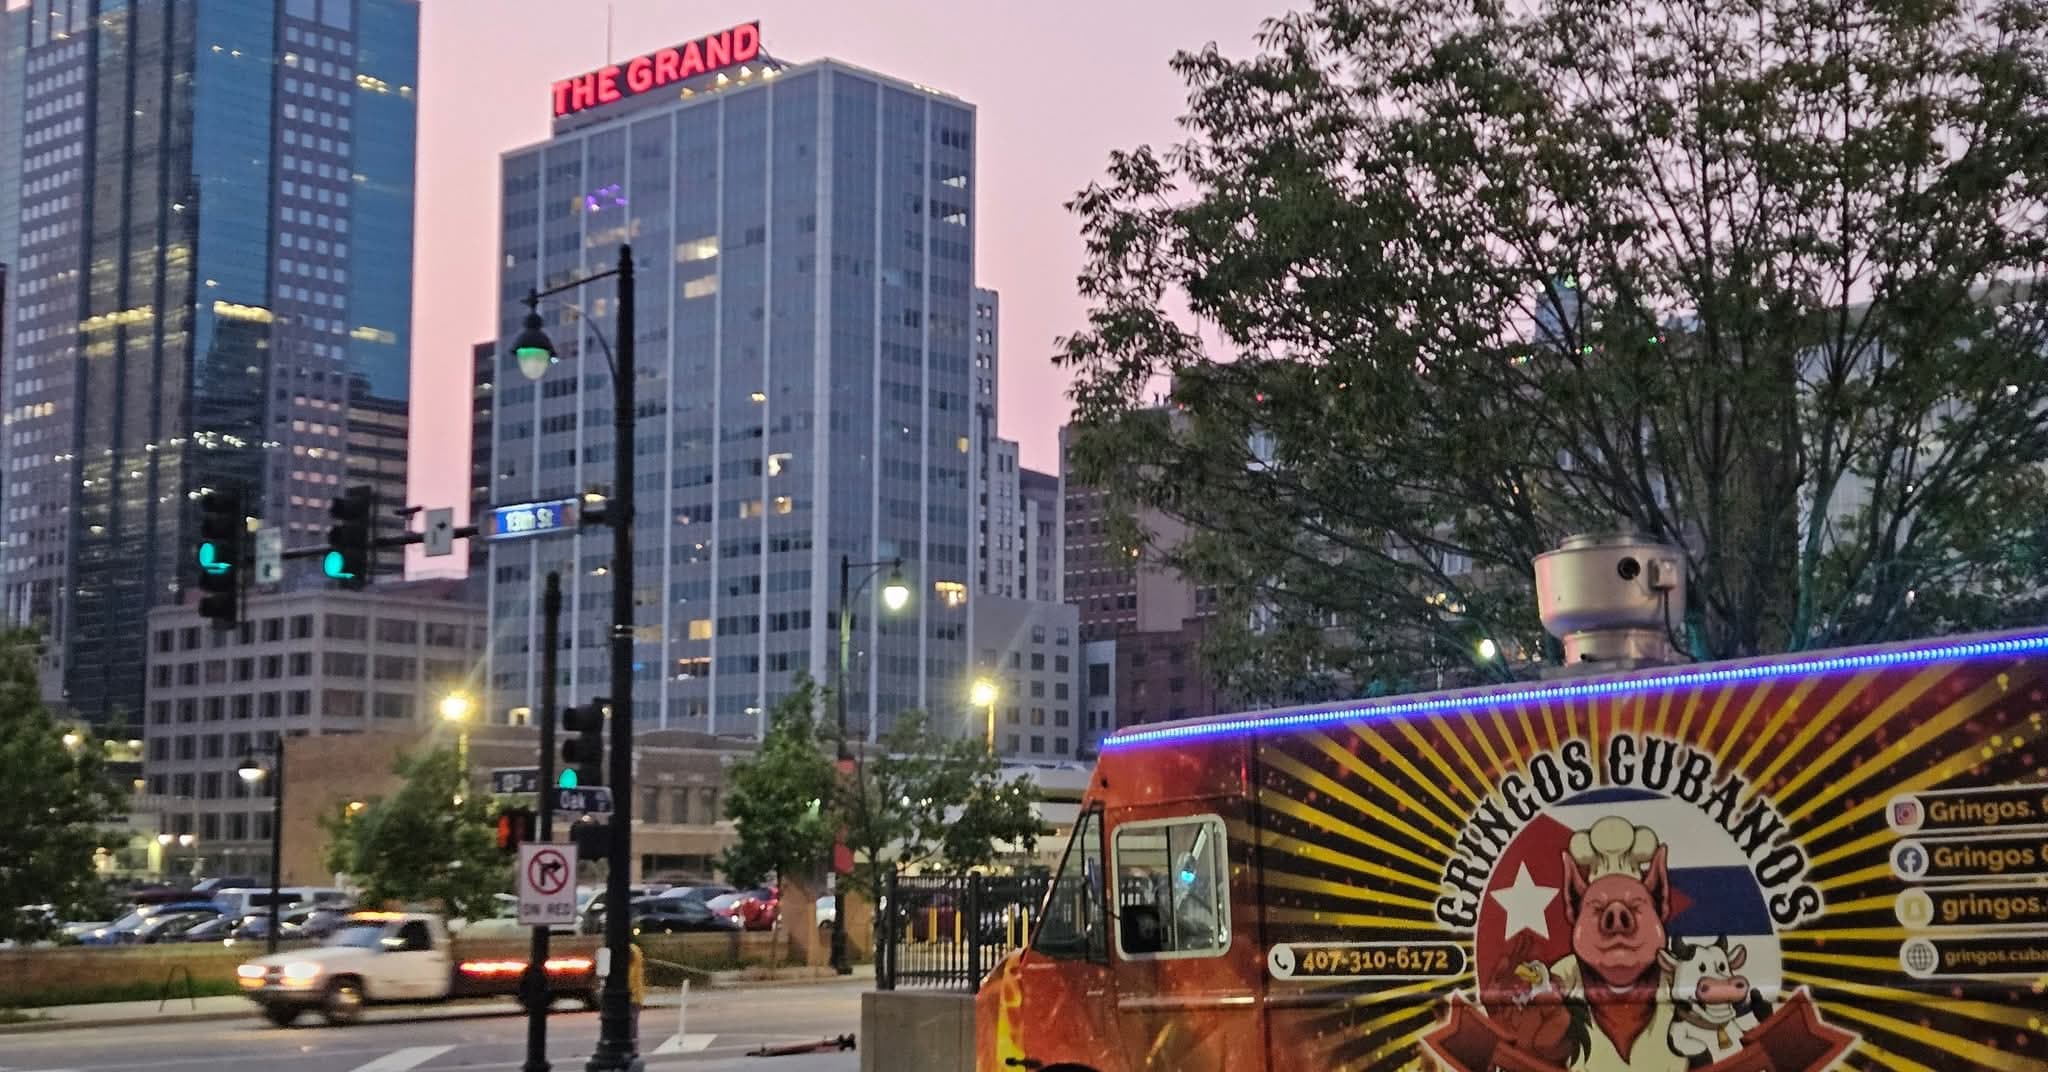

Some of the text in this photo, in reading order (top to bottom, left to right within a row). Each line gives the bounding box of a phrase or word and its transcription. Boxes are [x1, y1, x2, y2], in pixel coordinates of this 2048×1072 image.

[552, 22, 760, 117] THE GRAND
[1929, 799, 2036, 825] Gringos.
[1436, 733, 1820, 928] GRINGOS CUBANOS
[1934, 845, 2036, 872] Gringos
[523, 902, 571, 917] ON RED
[1941, 893, 2048, 920] gringos.
[1302, 947, 1448, 973] 407-310-6172
